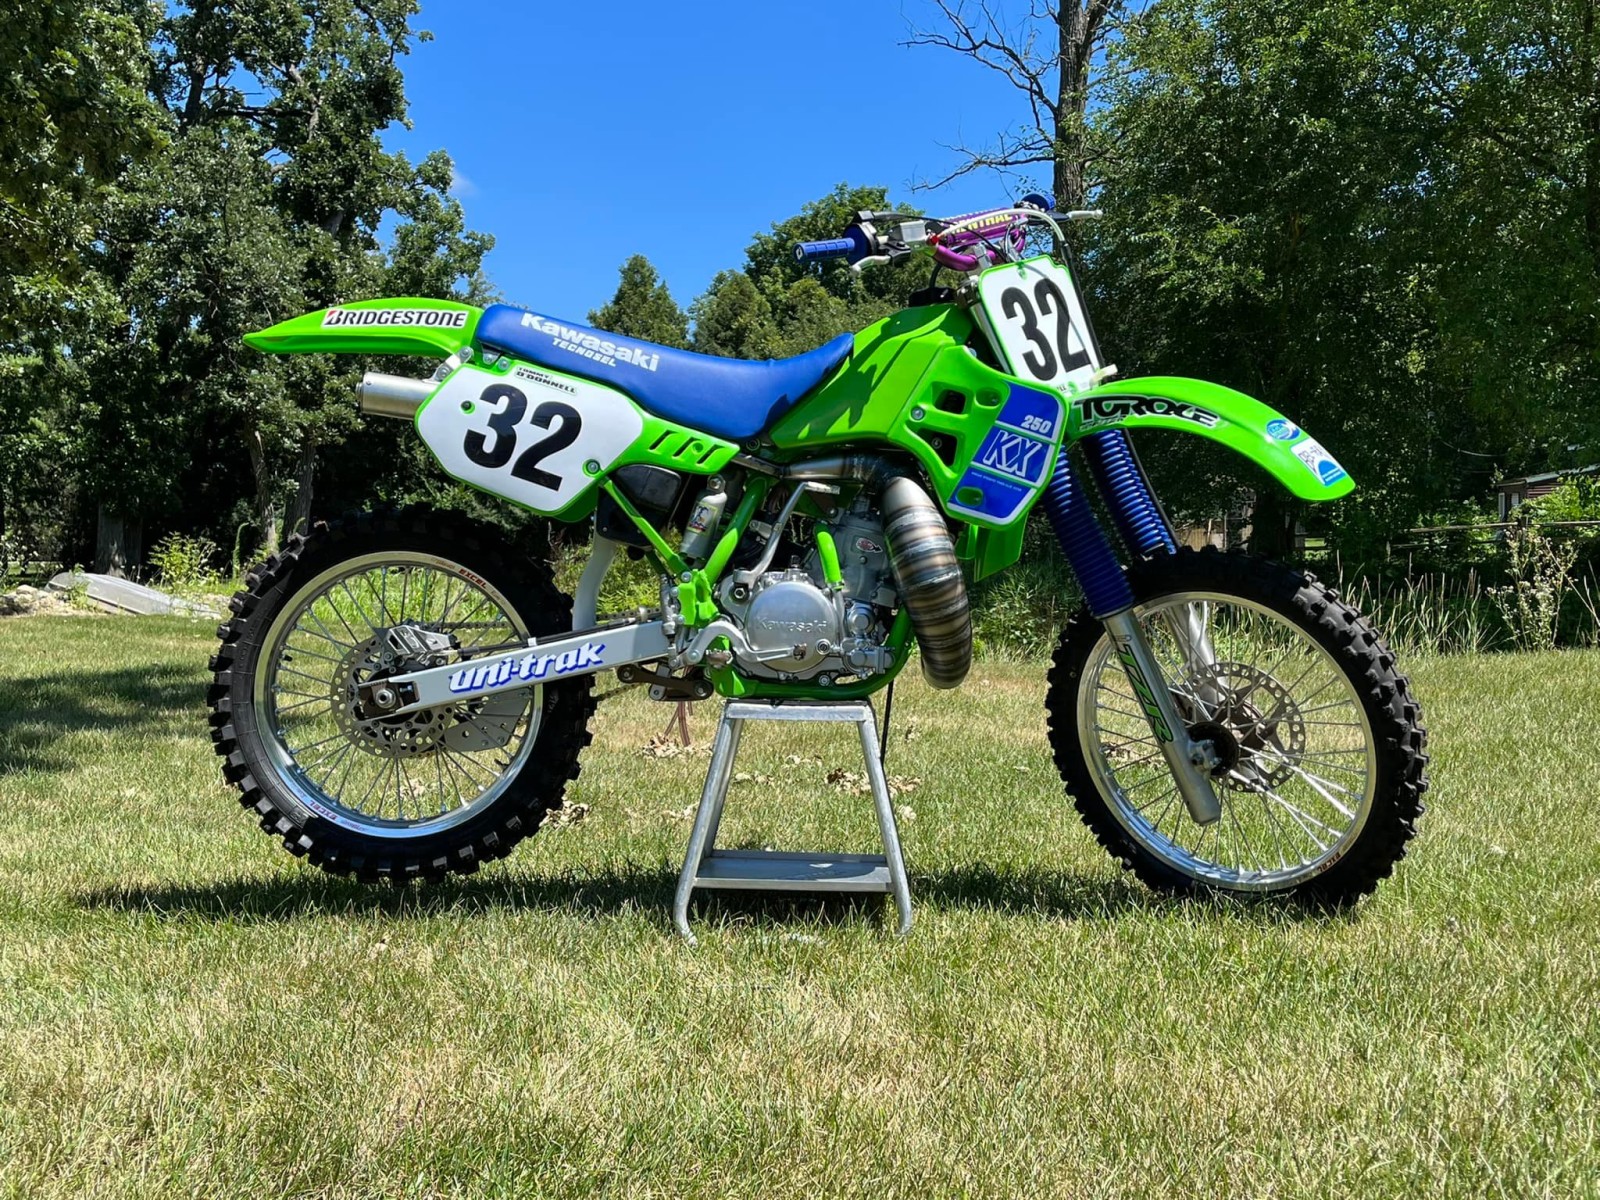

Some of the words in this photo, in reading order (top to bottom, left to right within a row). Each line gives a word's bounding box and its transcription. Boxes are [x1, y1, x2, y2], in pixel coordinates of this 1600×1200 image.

[950, 213, 1013, 236] ENTHAL
[324, 309, 467, 328] BRIDGESTONE
[1001, 277, 1091, 381] 32
[520, 312, 660, 372] Kawasaki
[552, 337, 617, 367] TECNOSEL
[1021, 414, 1052, 434] 250
[463, 383, 583, 492] 32
[982, 429, 1043, 477] KX
[459, 568, 486, 589] EXCEL
[755, 615, 828, 634] Kawasaki
